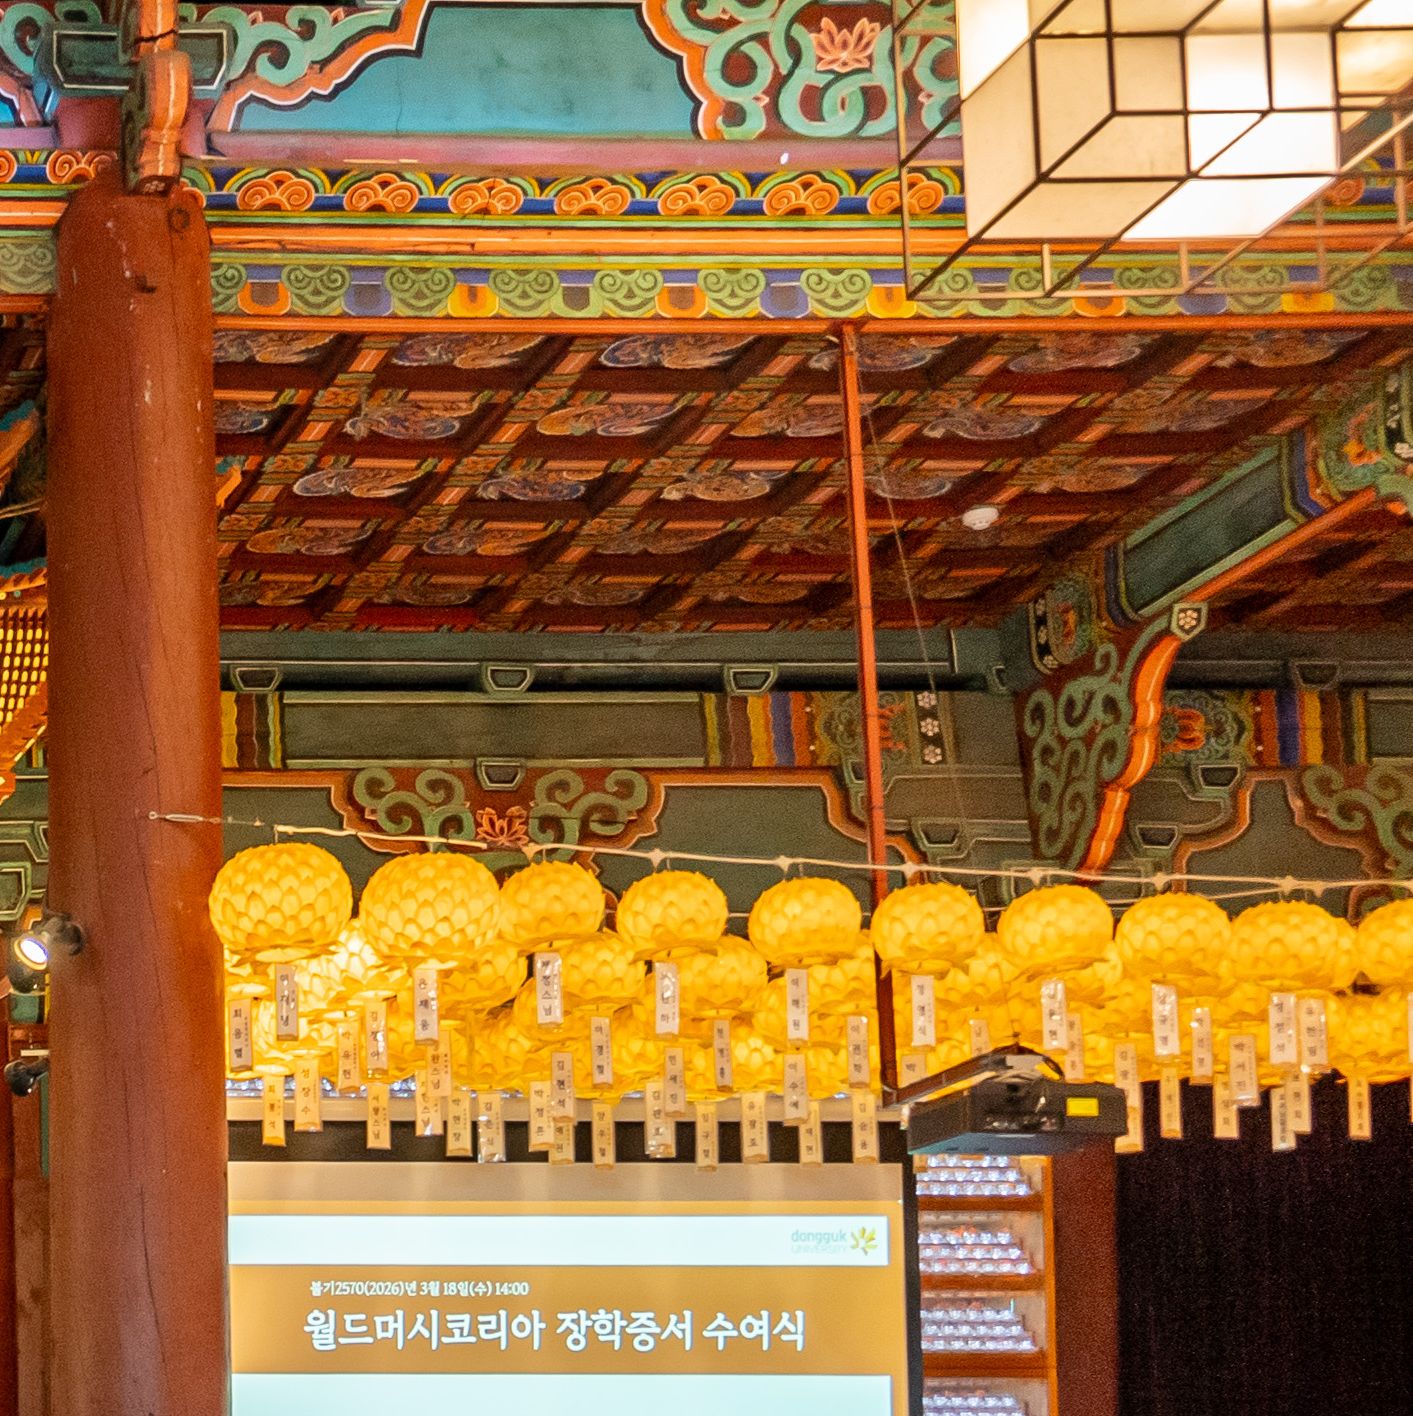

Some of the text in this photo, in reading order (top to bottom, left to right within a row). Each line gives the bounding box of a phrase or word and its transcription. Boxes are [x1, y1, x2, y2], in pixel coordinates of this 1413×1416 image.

[791, 1228, 848, 1244] dongguk
[310, 1280, 530, 1297] 불기2570(2026)년 3월 18일(수) 14:00
[303, 1308, 805, 1352] 월드머시코리아 장학증서 수여식
